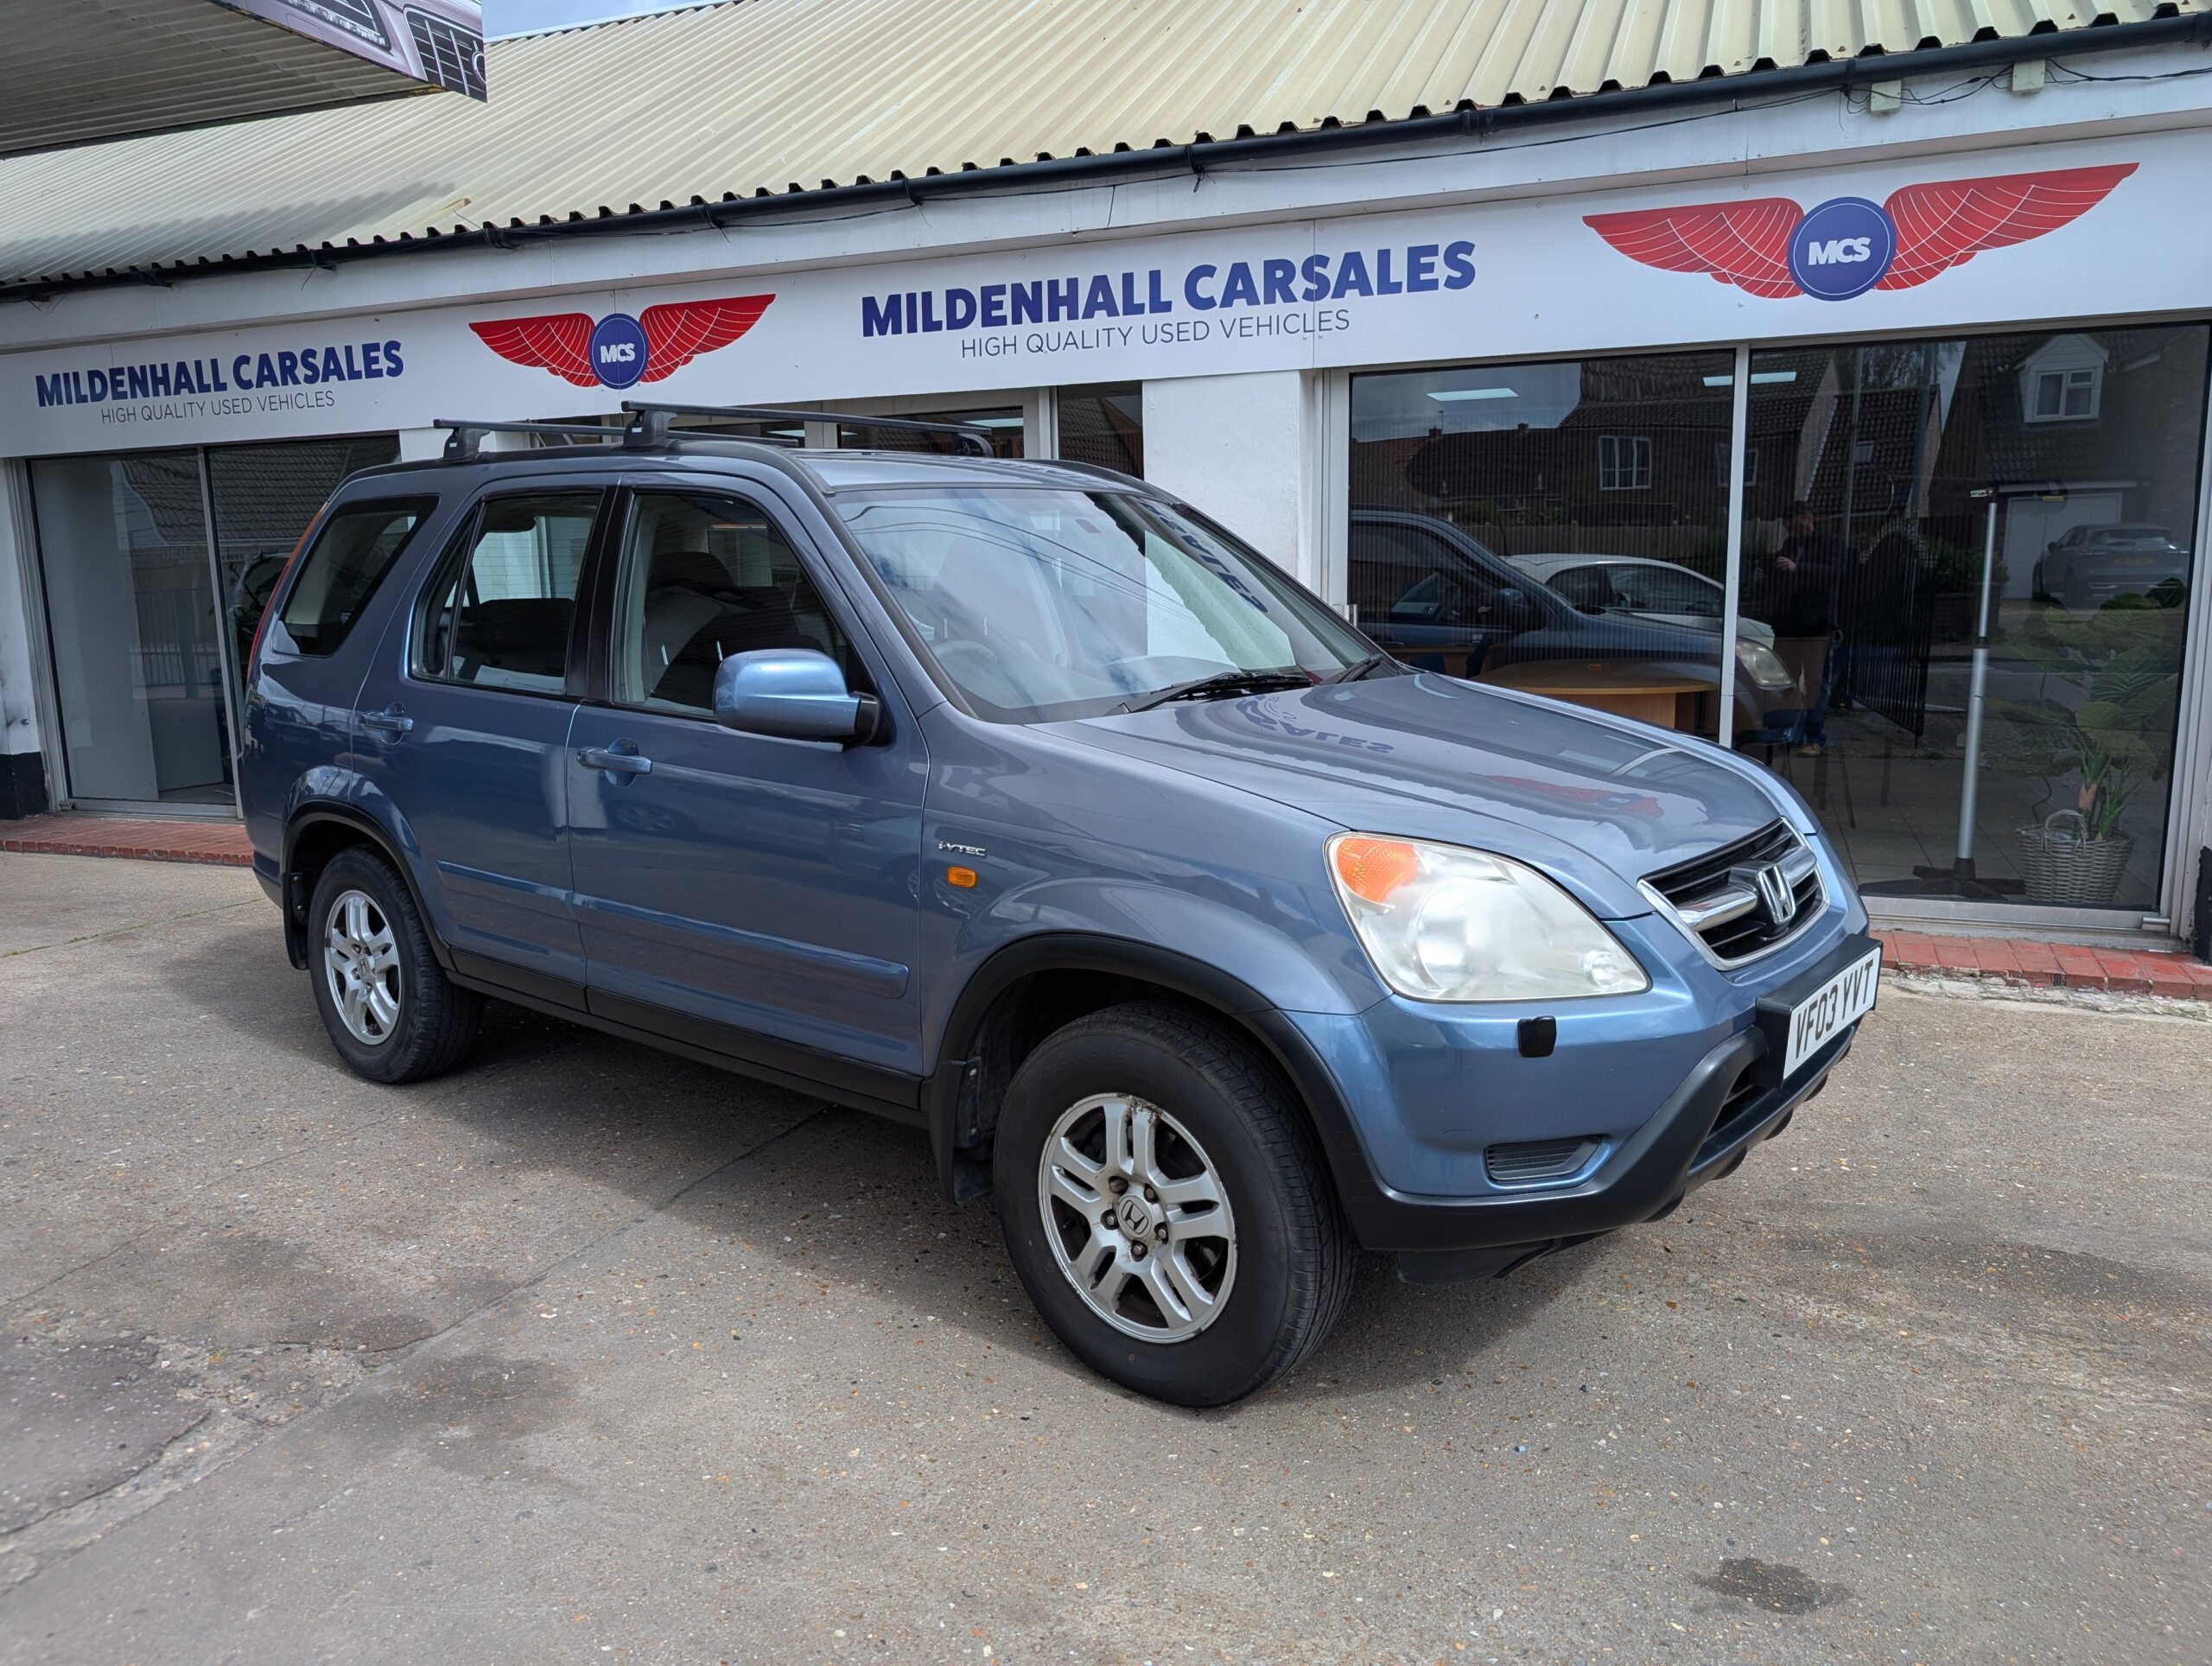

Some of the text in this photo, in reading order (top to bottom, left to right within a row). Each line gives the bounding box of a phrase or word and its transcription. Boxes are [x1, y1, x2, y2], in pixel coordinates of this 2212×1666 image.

[1808, 237, 1872, 266] MCS
[861, 240, 1476, 338] MILDENHALL CARSALES
[600, 342, 636, 364] MCS
[962, 308, 1351, 359] HIGH QUALITY USED VEHICLES
[35, 340, 405, 408] MILDENHALL CARSALES
[101, 390, 335, 425] HIGH QUALITY USED VEHICLES
[1795, 958, 1874, 1059] VF03 YVT
